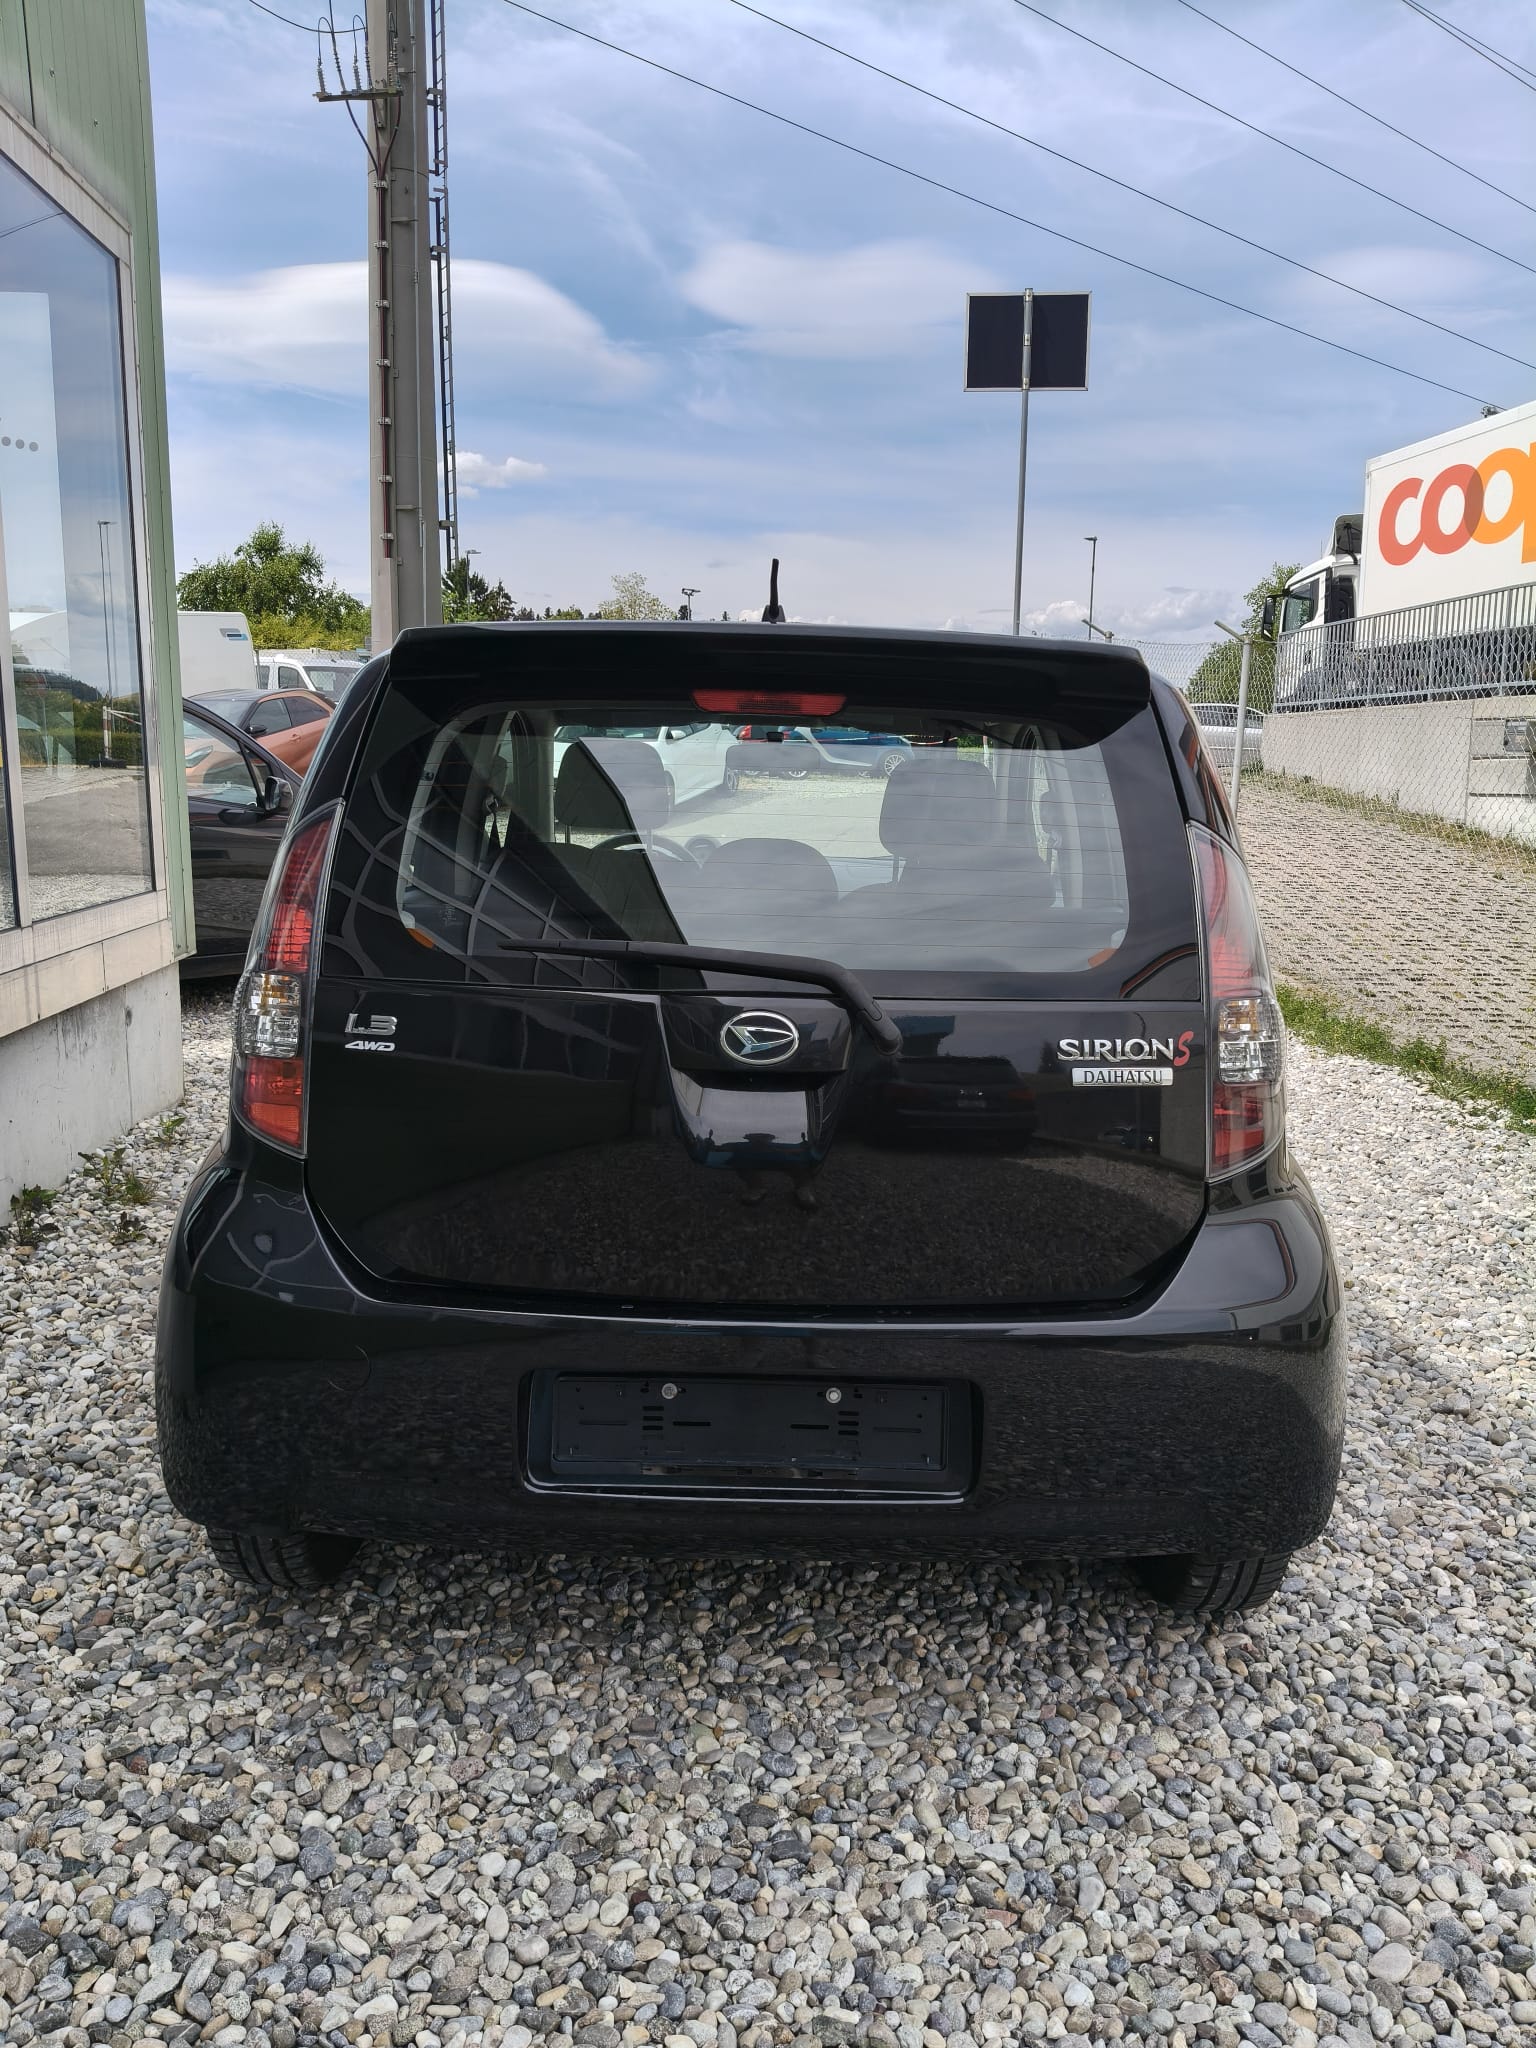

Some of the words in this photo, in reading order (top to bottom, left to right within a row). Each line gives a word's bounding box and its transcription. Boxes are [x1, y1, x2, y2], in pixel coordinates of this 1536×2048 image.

[344, 1013, 398, 1036] L3
[344, 1040, 396, 1052] 4WD
[1057, 1038, 1174, 1063] SIRION
[1083, 1070, 1164, 1084] DAIHATSU
